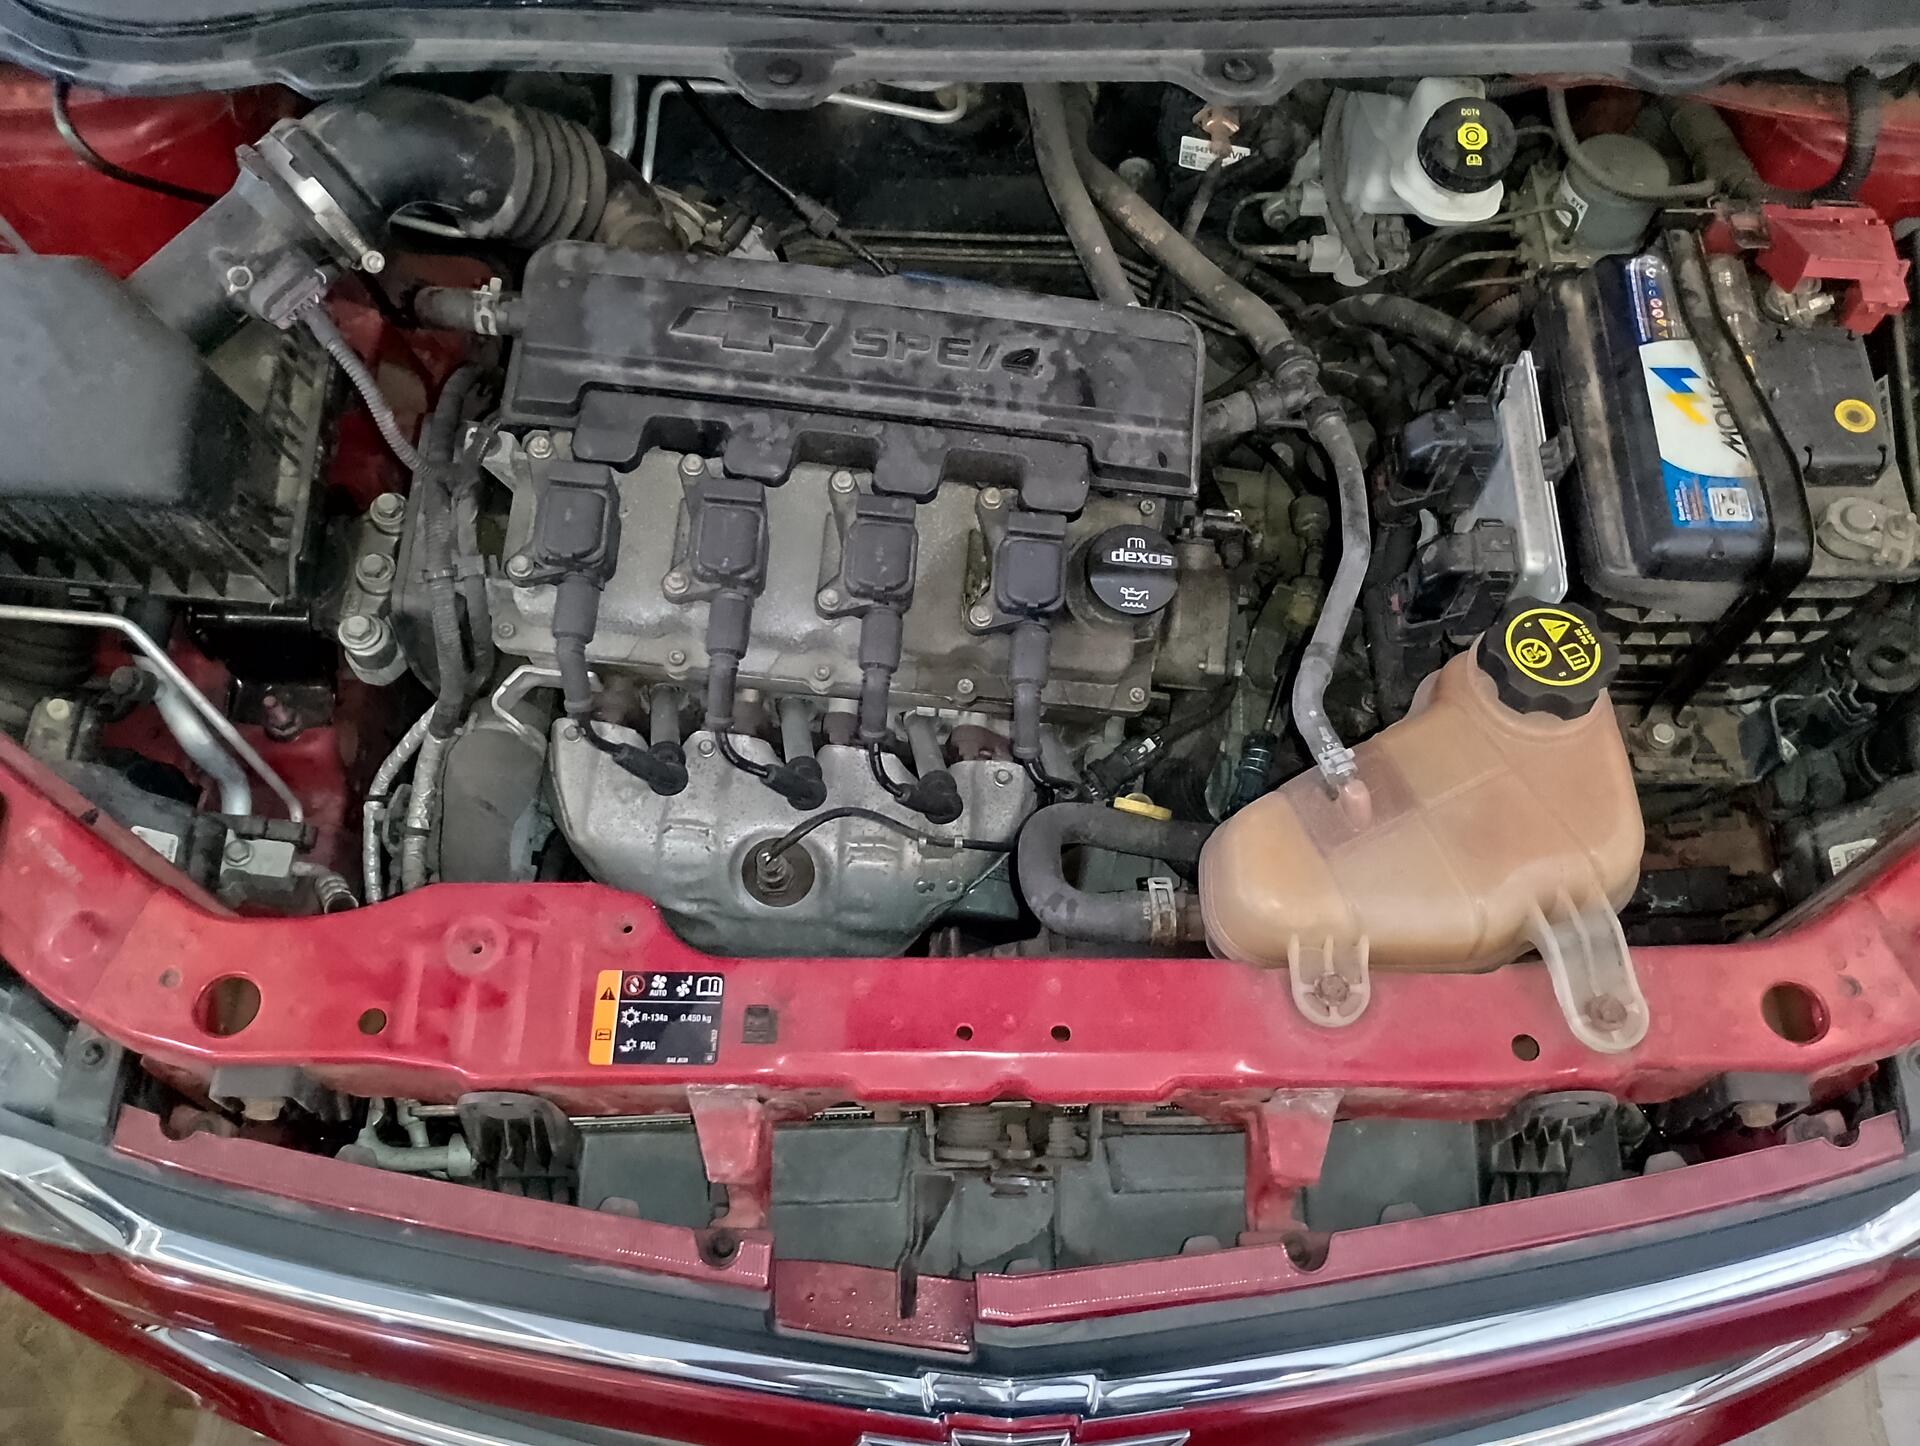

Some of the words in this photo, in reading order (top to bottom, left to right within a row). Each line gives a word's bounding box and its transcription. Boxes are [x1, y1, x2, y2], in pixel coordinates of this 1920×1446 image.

[1461, 108, 1480, 116] DOT4
[1111, 548, 1174, 566] dexos
[649, 989, 667, 997] AUTO
[641, 1012, 668, 1022] R-134a
[680, 1013, 701, 1022] 0.450
[702, 1014, 712, 1024] kg
[640, 1040, 656, 1050] PAG
